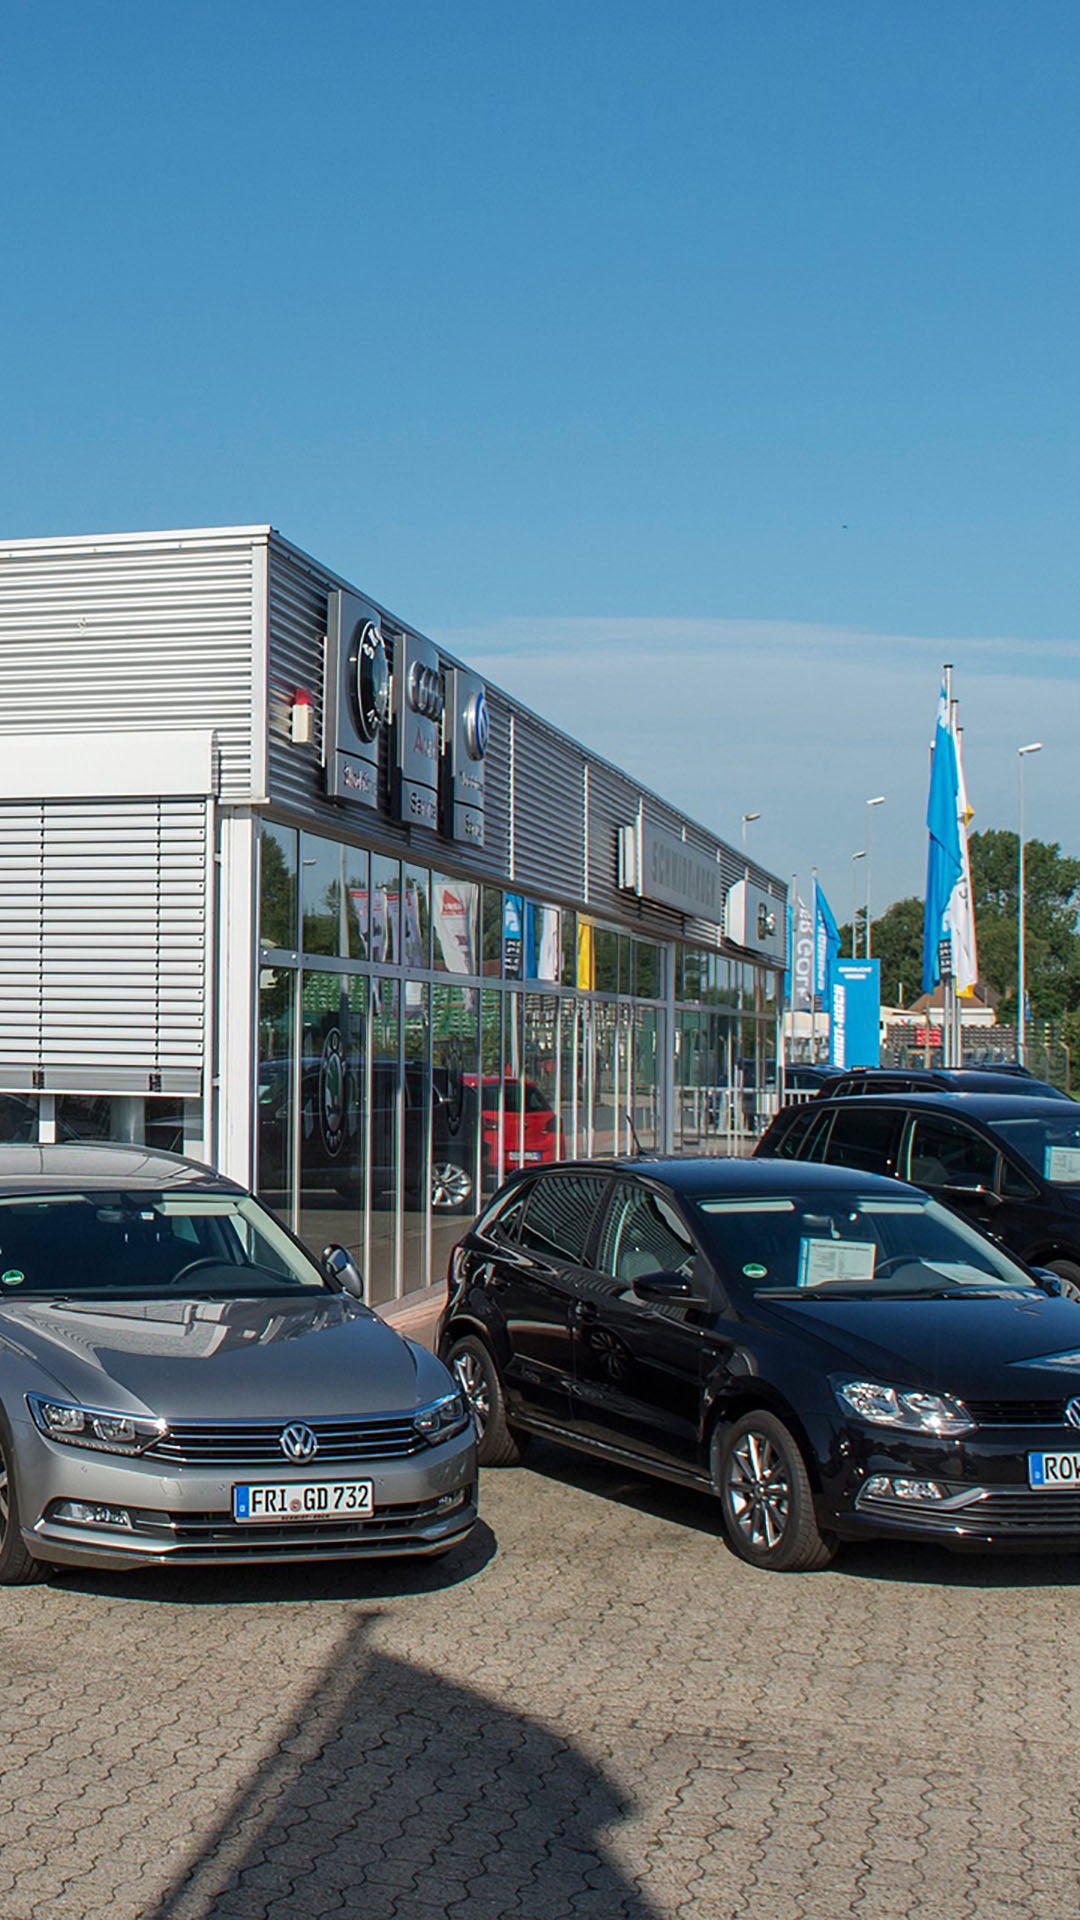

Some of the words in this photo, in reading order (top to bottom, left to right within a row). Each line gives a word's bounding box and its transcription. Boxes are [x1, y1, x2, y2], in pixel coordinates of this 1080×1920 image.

[252, 1489, 287, 1513] FRI
[304, 1487, 328, 1511] GD
[334, 1484, 369, 1509] 732
